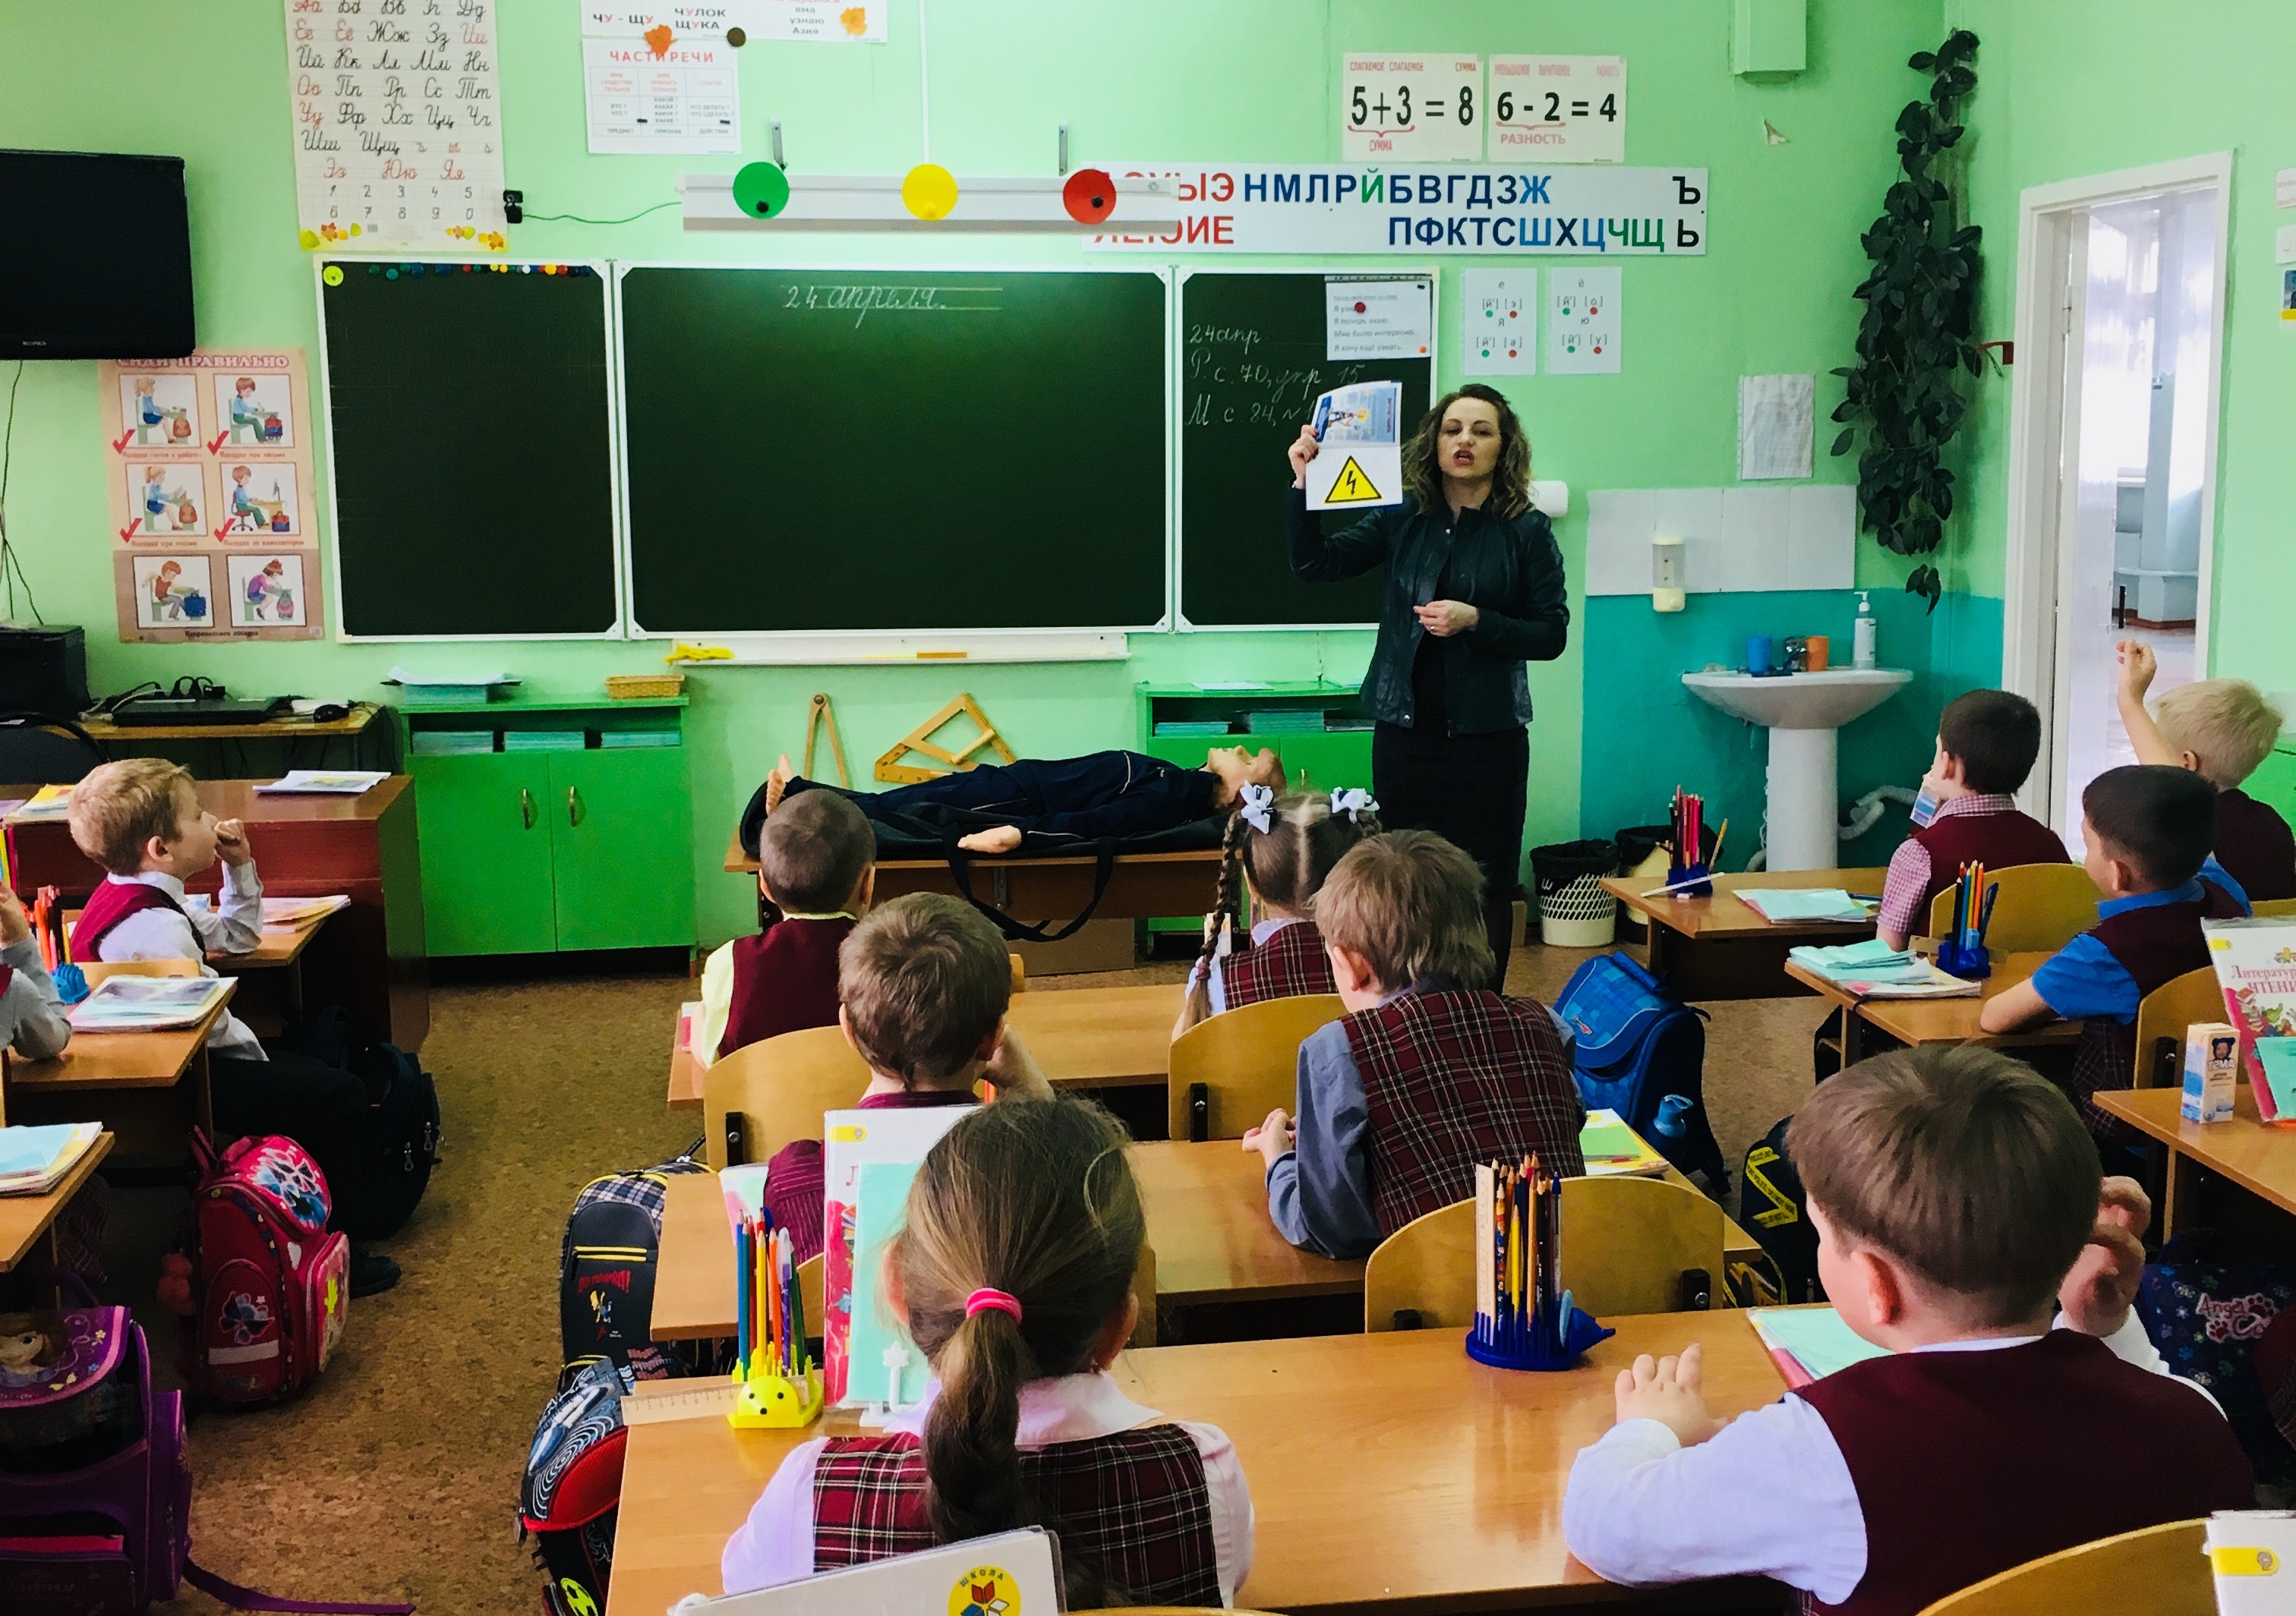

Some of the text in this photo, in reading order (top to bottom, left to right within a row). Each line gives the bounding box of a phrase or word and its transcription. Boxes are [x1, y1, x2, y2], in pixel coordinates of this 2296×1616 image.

[675, 8, 727, 17] ЧУЛОК
[593, 14, 613, 23] ЧУ
[629, 14, 654, 25] ЩУ
[676, 20, 720, 30] ЩУКА
[610, 50, 714, 62] ЧАСТИ РЕЧИ
[1350, 61, 1476, 71] СЛАГАЕМОЕ СЛАГАЕМОЕ СУММА
[1369, 139, 1392, 152] СУММА
[1500, 134, 1566, 145] РАЗНОСТЬ
[364, 184, 371, 197] 2
[397, 184, 405, 198] 3
[431, 185, 439, 198] 4
[465, 186, 472, 199] 5
[330, 206, 338, 219] 6
[364, 206, 372, 219] 7
[399, 206, 406, 219] 8
[431, 206, 440, 219] 9
[785, 285, 818, 310] 24
[176, 355, 289, 368] ПРАВИЛЬНО
[2199, 1296, 2245, 1319] Angel
[959, 1569, 1004, 1588] ШКОЛА
